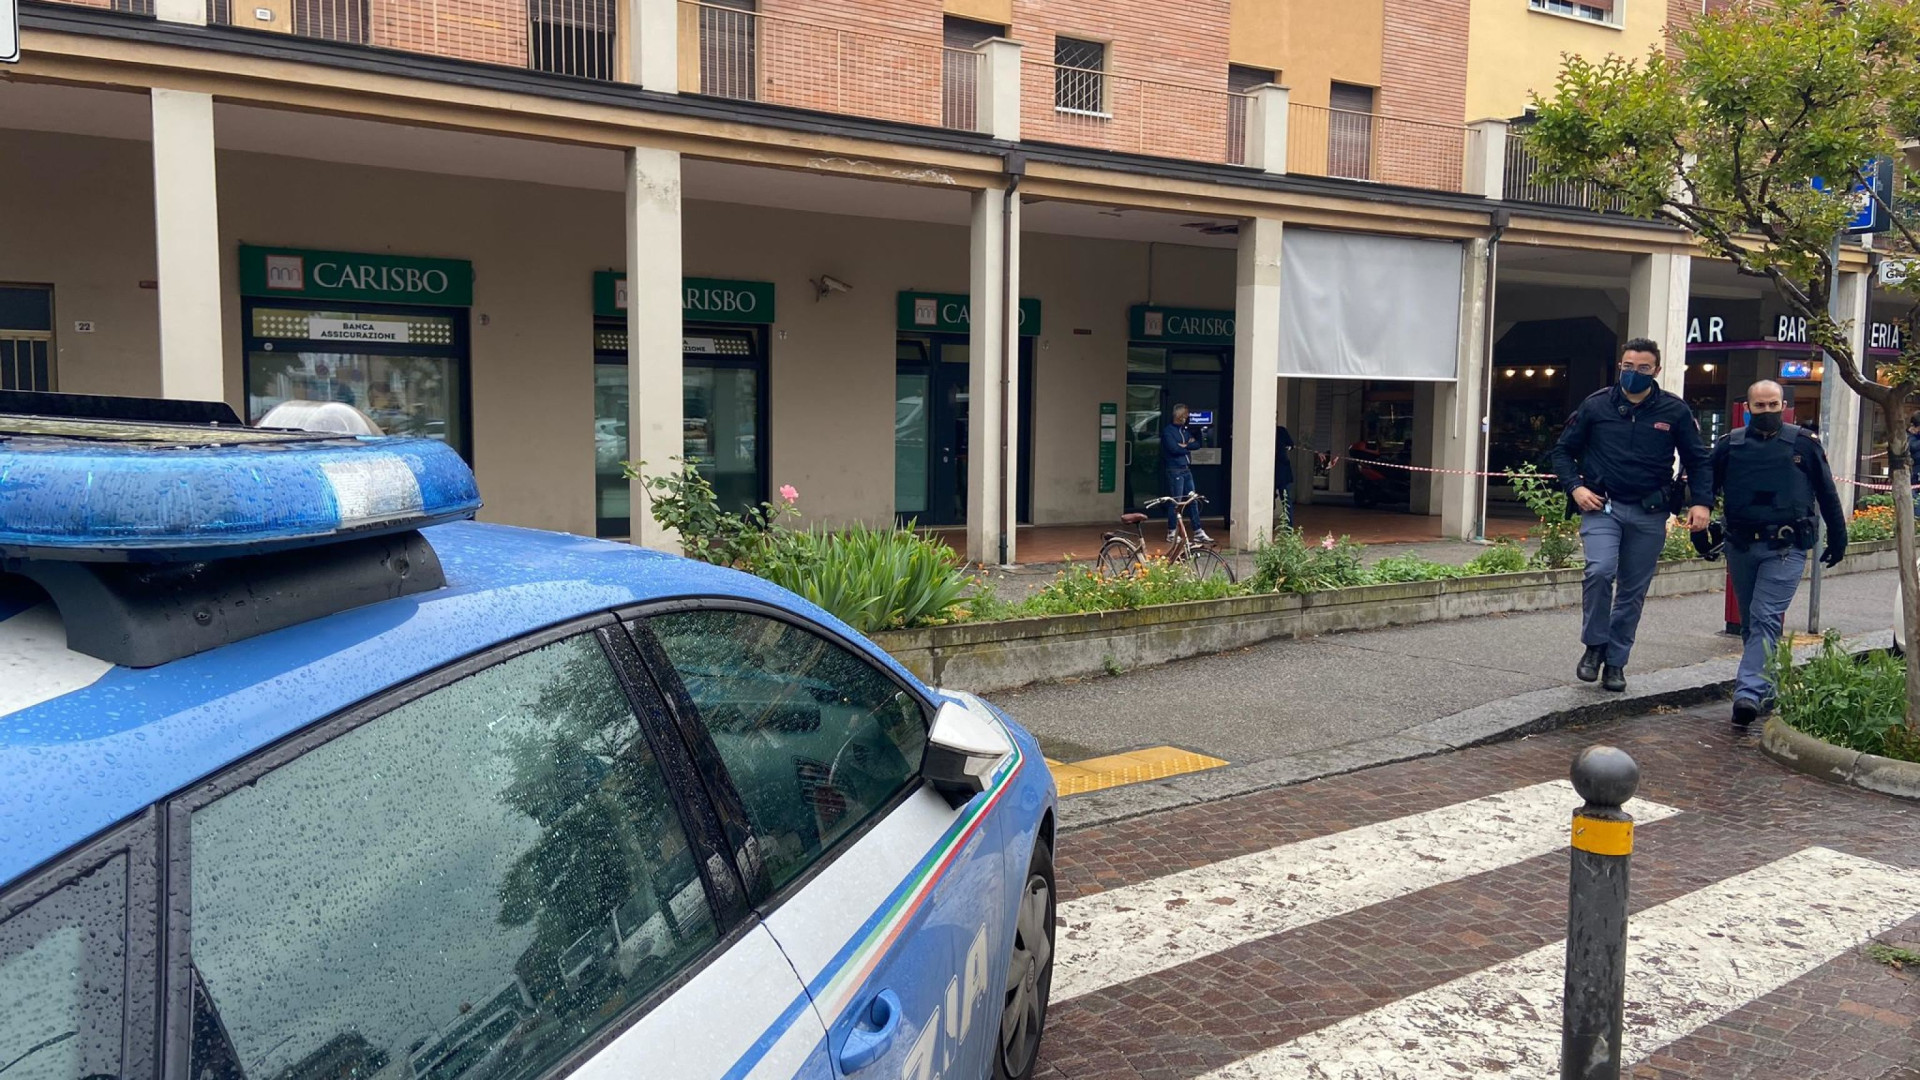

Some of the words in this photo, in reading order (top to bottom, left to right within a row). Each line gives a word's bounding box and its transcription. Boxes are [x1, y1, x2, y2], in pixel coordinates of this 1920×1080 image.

[313, 263, 448, 294] CARISBO
[682, 288, 756, 312] RISBO
[79, 322, 91, 331] 22
[321, 331, 396, 339] ASSICURAZIONE
[1167, 316, 1236, 336] CARISBO
[1778, 315, 1806, 342] BAR
[1869, 322, 1899, 348] ERIA
